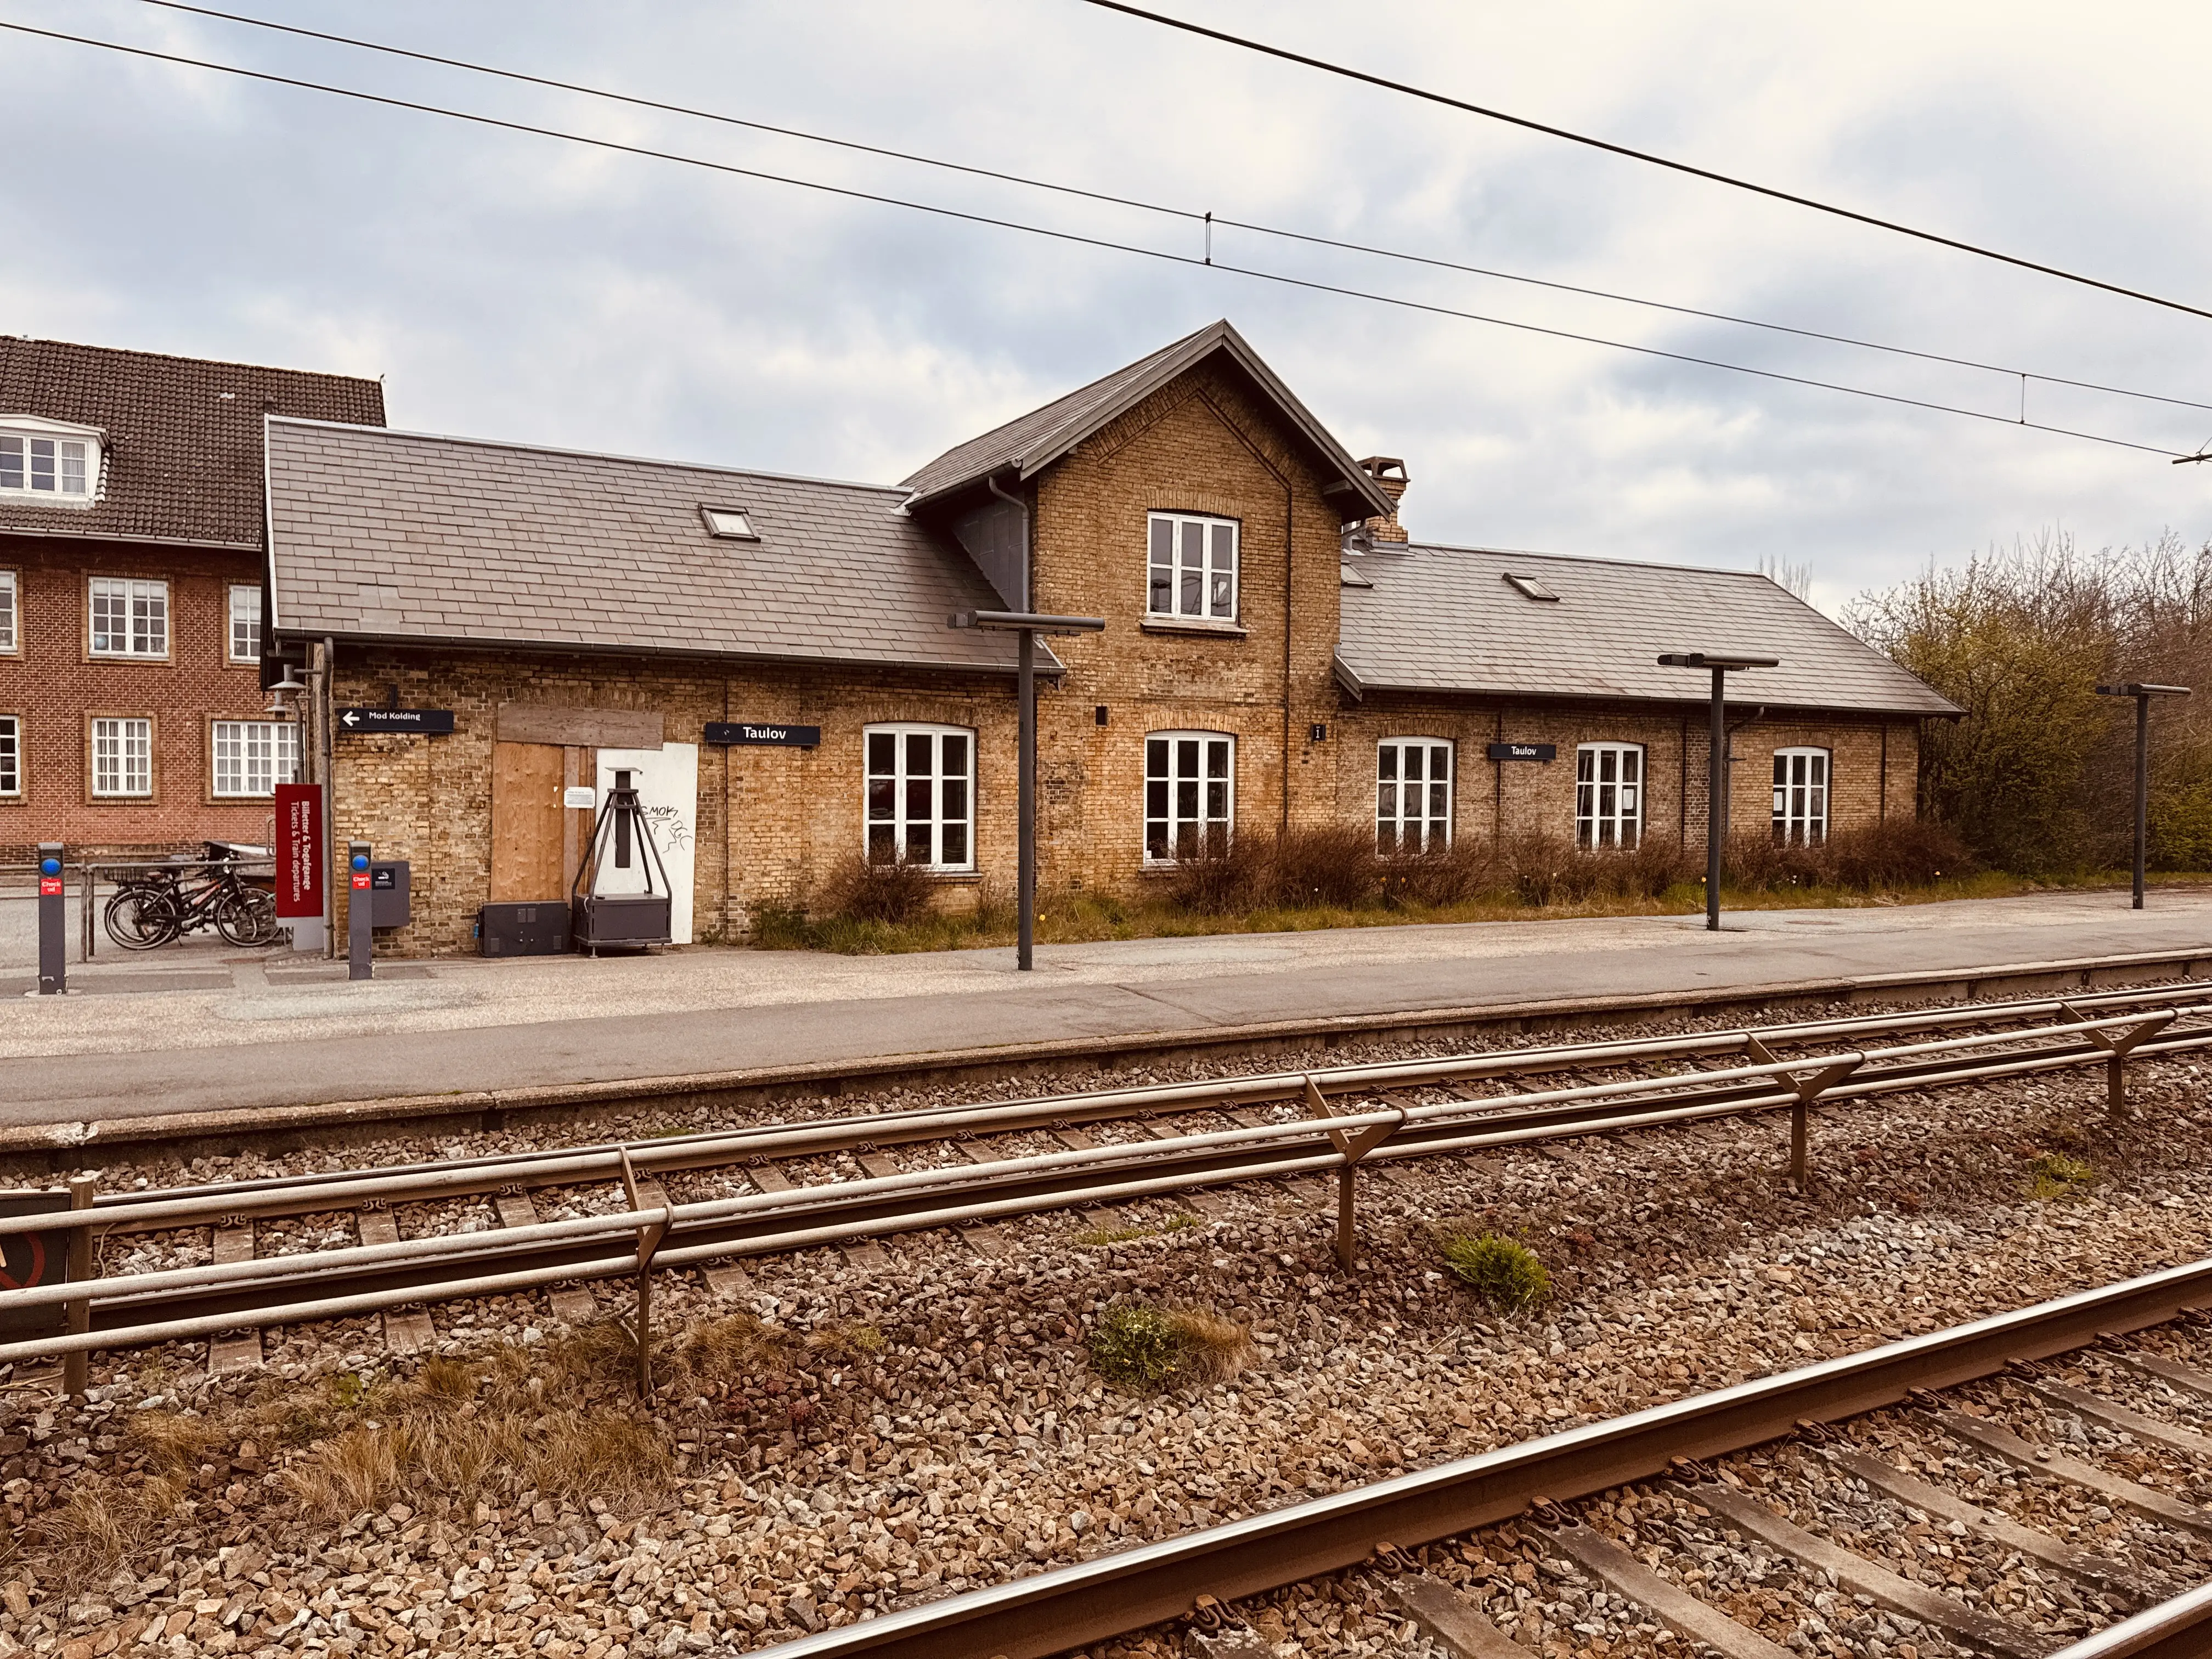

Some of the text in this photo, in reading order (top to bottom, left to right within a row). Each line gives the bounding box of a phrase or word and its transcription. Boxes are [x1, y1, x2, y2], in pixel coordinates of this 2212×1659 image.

[390, 713, 420, 721] Kolding
[743, 726, 786, 739] Taulov
[1316, 729, 1320, 738] 1
[1511, 746, 1537, 755] Taulov
[291, 801, 300, 829] Tickets
[302, 801, 311, 833] Billetter
[292, 839, 300, 859] Train
[302, 843, 312, 890] Togafgange
[291, 859, 301, 902] departures
